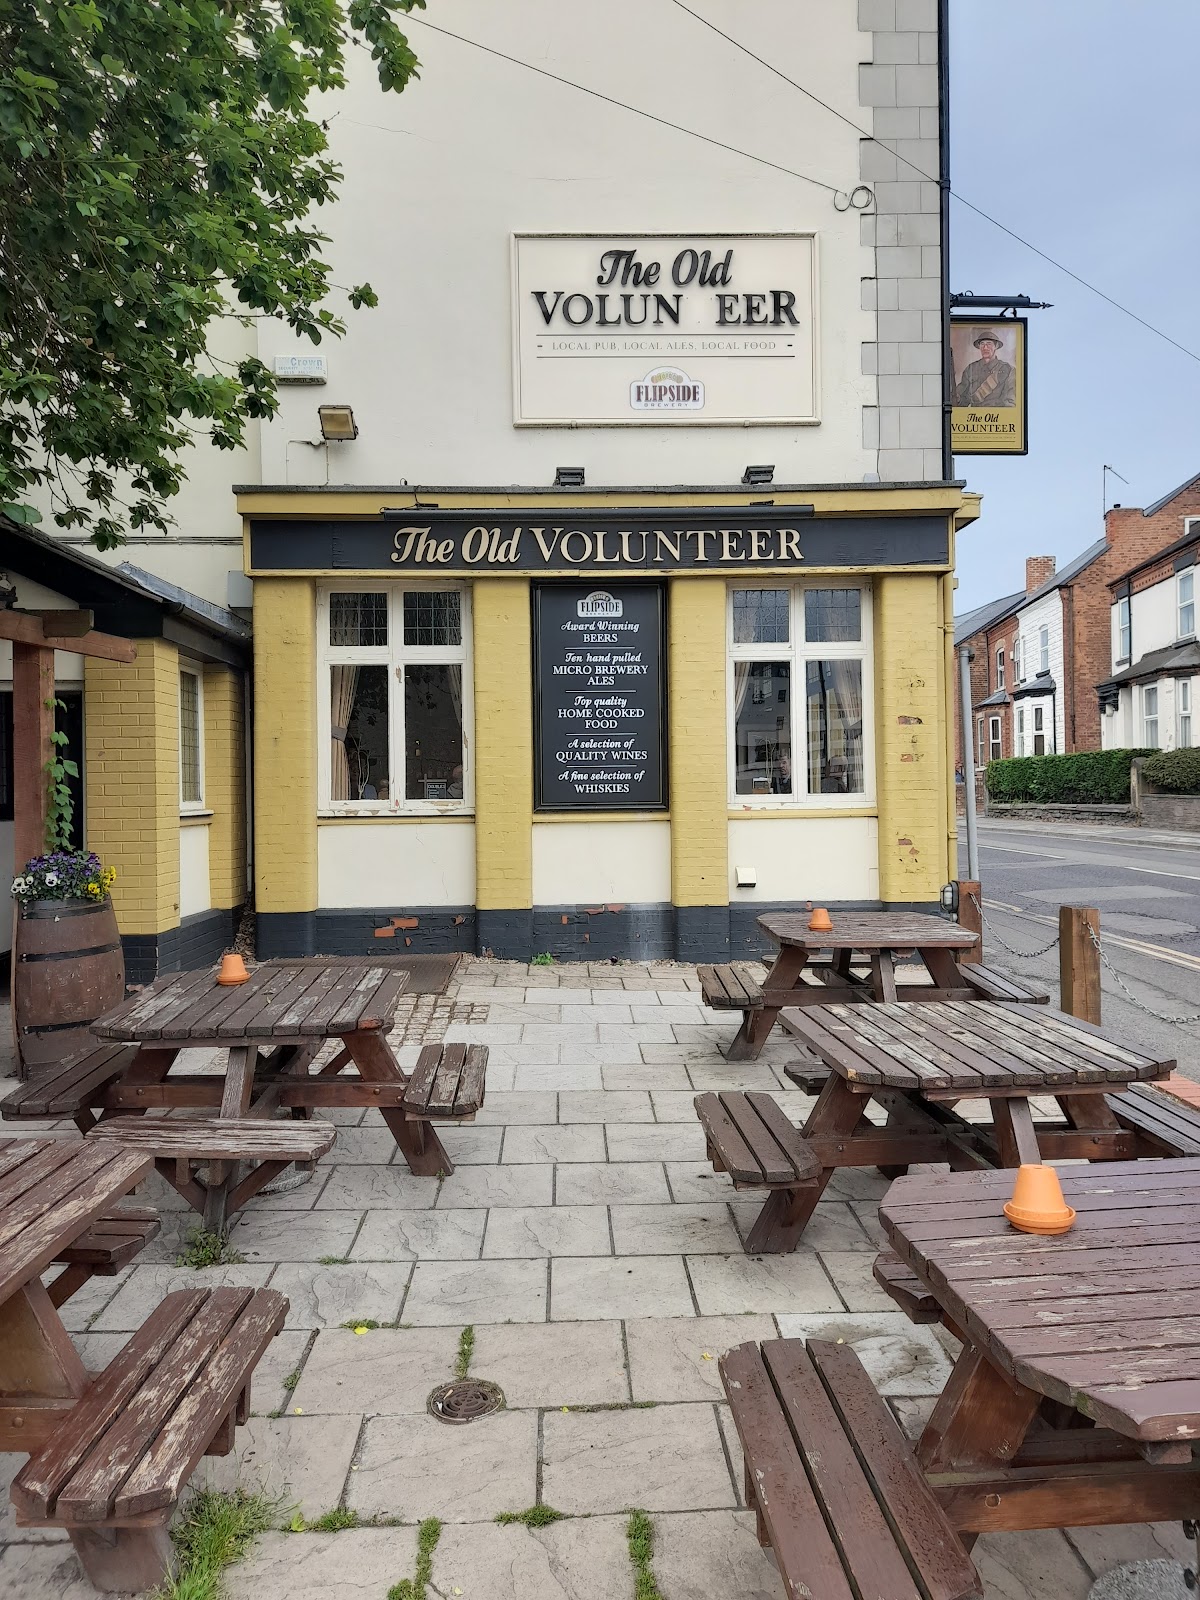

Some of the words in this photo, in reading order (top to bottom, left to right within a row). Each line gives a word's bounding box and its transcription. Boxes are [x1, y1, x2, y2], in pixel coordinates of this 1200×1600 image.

[597, 249, 661, 287] The
[671, 248, 734, 287] Old
[552, 341, 591, 351] LOCAL
[595, 341, 620, 352] PUB,
[624, 341, 663, 351] LOCAL
[666, 341, 697, 352] ALES,
[701, 341, 740, 350] LOCAL
[743, 341, 776, 350] FOOD
[291, 357, 322, 366] Crown
[636, 384, 700, 402] FLIPSIDE
[966, 413, 982, 422] The
[984, 413, 999, 422] Old
[951, 423, 1016, 432] VOLUNTEER
[390, 526, 455, 563] The
[461, 526, 523, 563] Old
[528, 527, 805, 563] VOLUNTEER
[580, 601, 620, 612] FLIPSIDE
[561, 621, 596, 630] Award
[596, 621, 640, 632] Winning
[583, 633, 618, 643] BEERS
[565, 652, 583, 663] Ten
[586, 652, 612, 663] hand
[611, 652, 642, 665] pulled
[552, 665, 592, 675] MICRO
[594, 665, 649, 675] BREWERY
[586, 676, 615, 686] ALES
[574, 695, 592, 708] Top
[593, 695, 627, 708] quality
[557, 708, 593, 718] HOME
[595, 708, 645, 718] COOKED
[584, 719, 618, 729] FOOD
[568, 738, 579, 749] A
[579, 738, 622, 749] selection
[623, 738, 635, 750] of
[555, 751, 608, 763] QUALITY
[611, 750, 648, 760] WINES
[558, 770, 570, 781] A
[570, 771, 588, 782] fine
[590, 770, 632, 781] selection
[634, 770, 646, 782] of
[574, 783, 630, 793] WHISKIES
